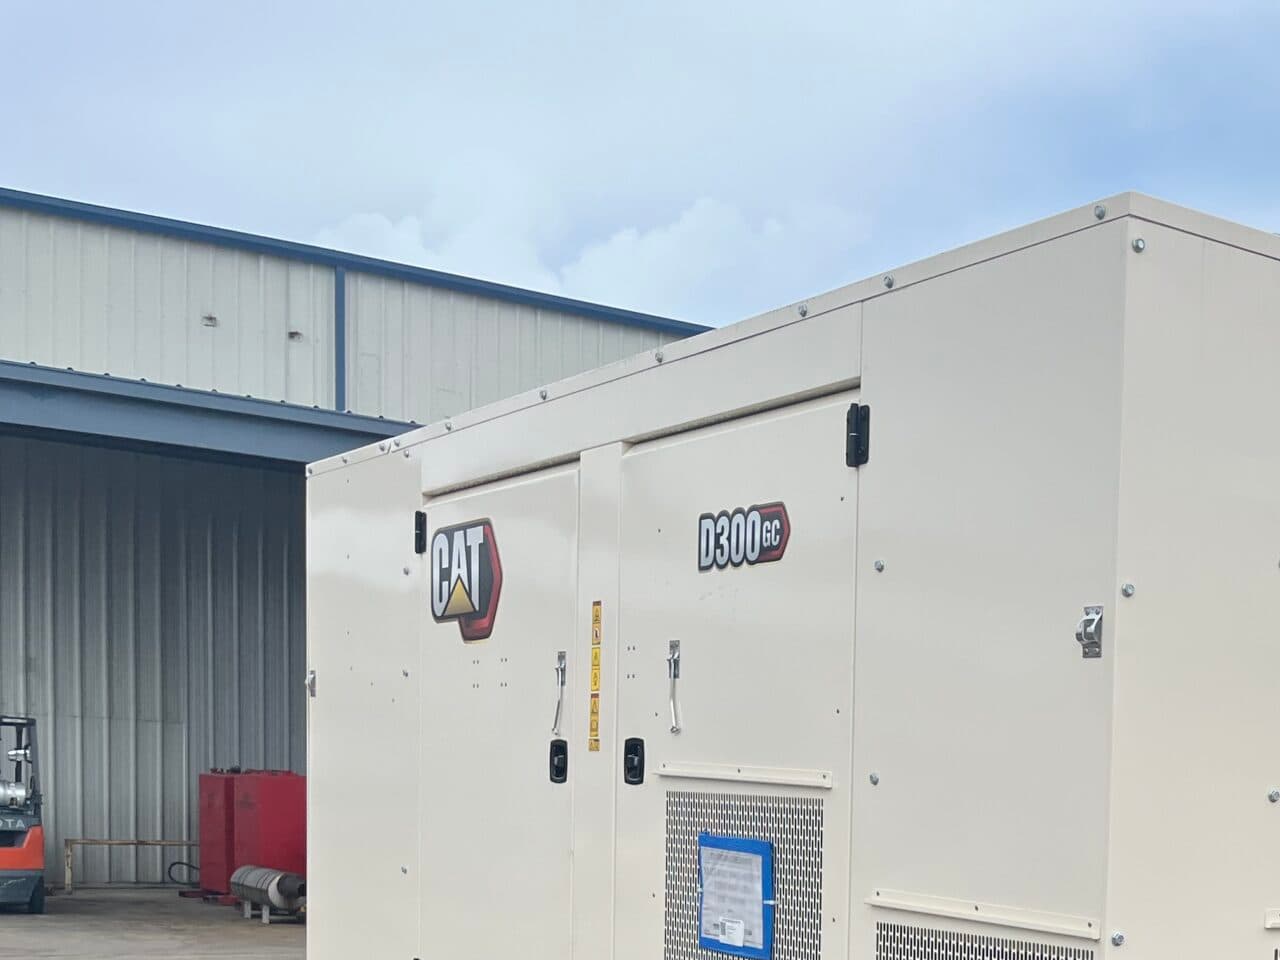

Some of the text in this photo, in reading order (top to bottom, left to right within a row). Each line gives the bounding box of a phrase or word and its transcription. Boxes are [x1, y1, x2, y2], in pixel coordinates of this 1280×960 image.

[432, 525, 484, 617] CAT
[700, 510, 781, 567] D300 GC
